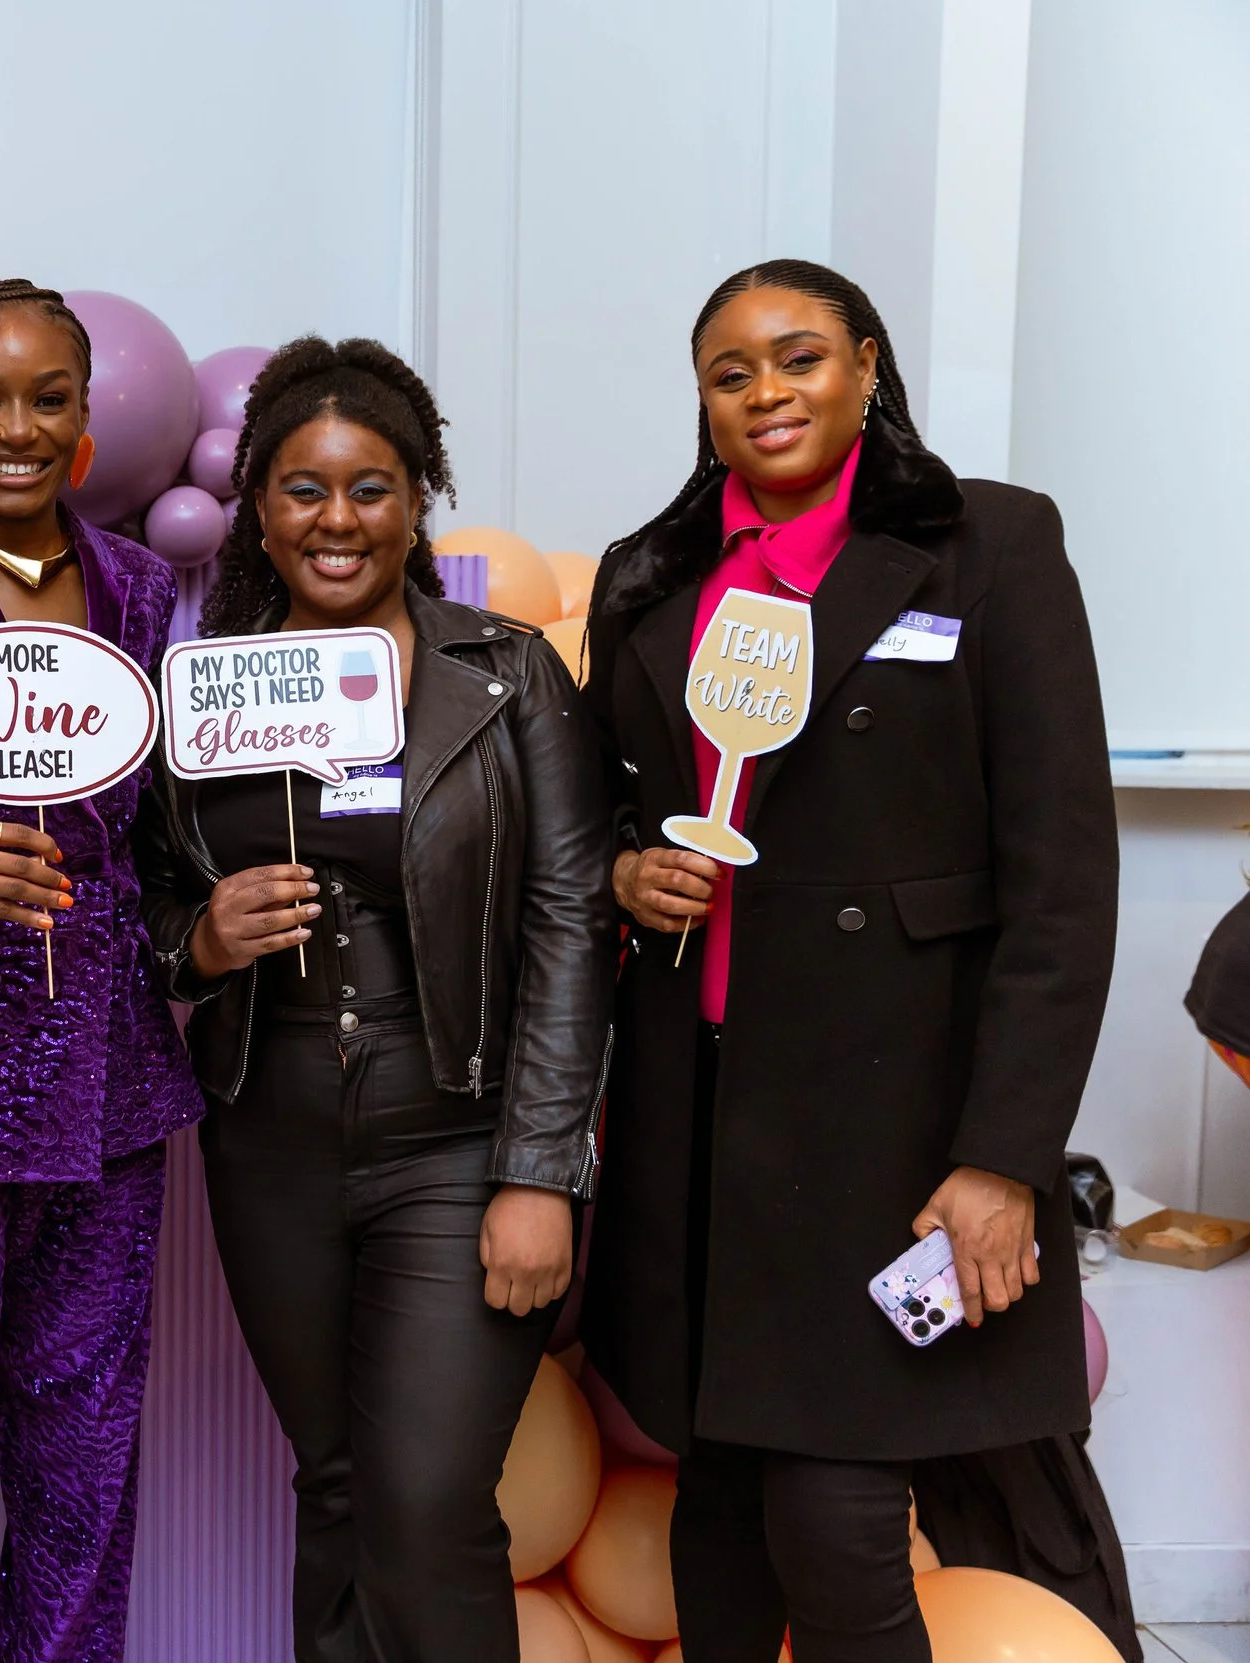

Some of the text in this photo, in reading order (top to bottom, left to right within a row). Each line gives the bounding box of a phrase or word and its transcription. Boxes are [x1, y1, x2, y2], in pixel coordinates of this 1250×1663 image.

[897, 612, 933, 628] ELLO
[720, 618, 800, 674] TEAM
[190, 647, 321, 684] MY DOCTOR
[190, 676, 325, 713] SAYS I NEED
[693, 670, 797, 726] White
[186, 710, 337, 766] Glasses
[331, 787, 374, 802] Angel
